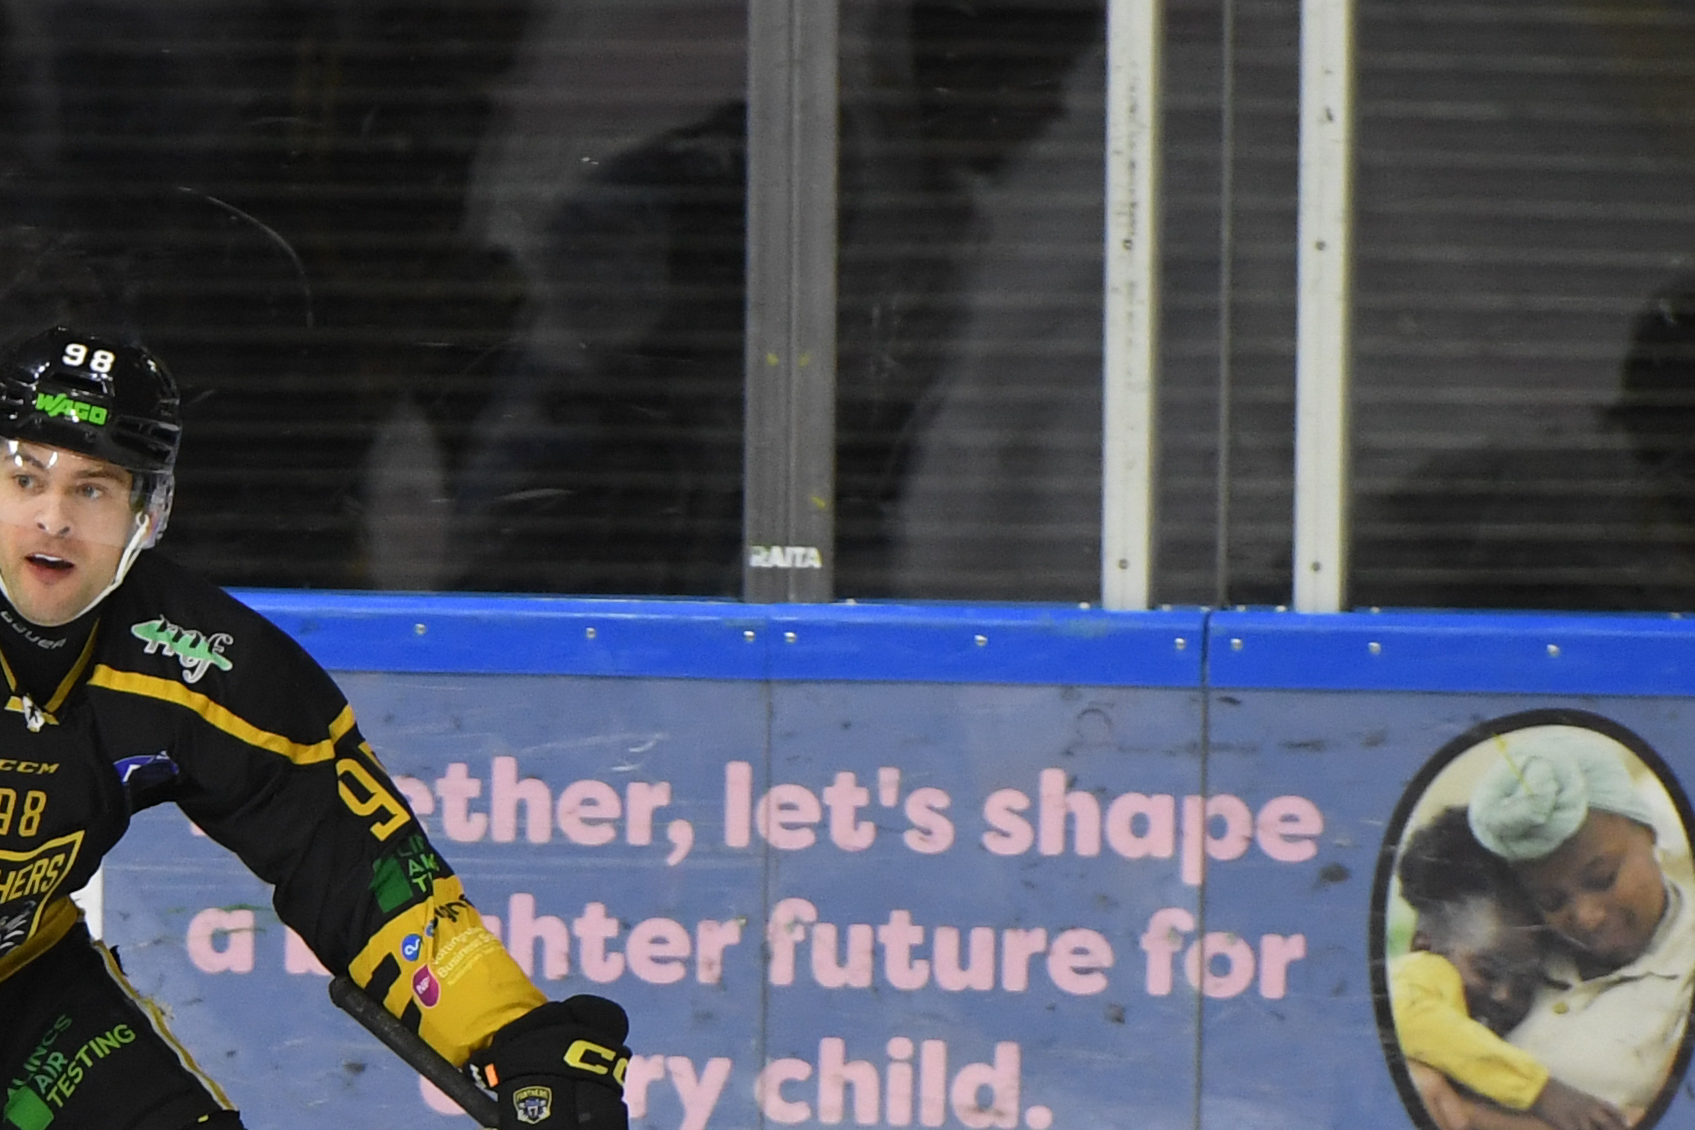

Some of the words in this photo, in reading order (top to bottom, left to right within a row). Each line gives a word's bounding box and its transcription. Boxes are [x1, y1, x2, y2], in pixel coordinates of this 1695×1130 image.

[62, 343, 115, 373] 98
[35, 393, 107, 425] WAGO
[724, 760, 955, 854] let's
[982, 768, 1325, 885] shape
[187, 907, 254, 973] a
[766, 898, 1114, 995] future
[1141, 908, 1306, 999] for
[35, 1051, 68, 1094] AIR
[46, 1024, 136, 1108] TESTING
[754, 1036, 1053, 1130] child.
